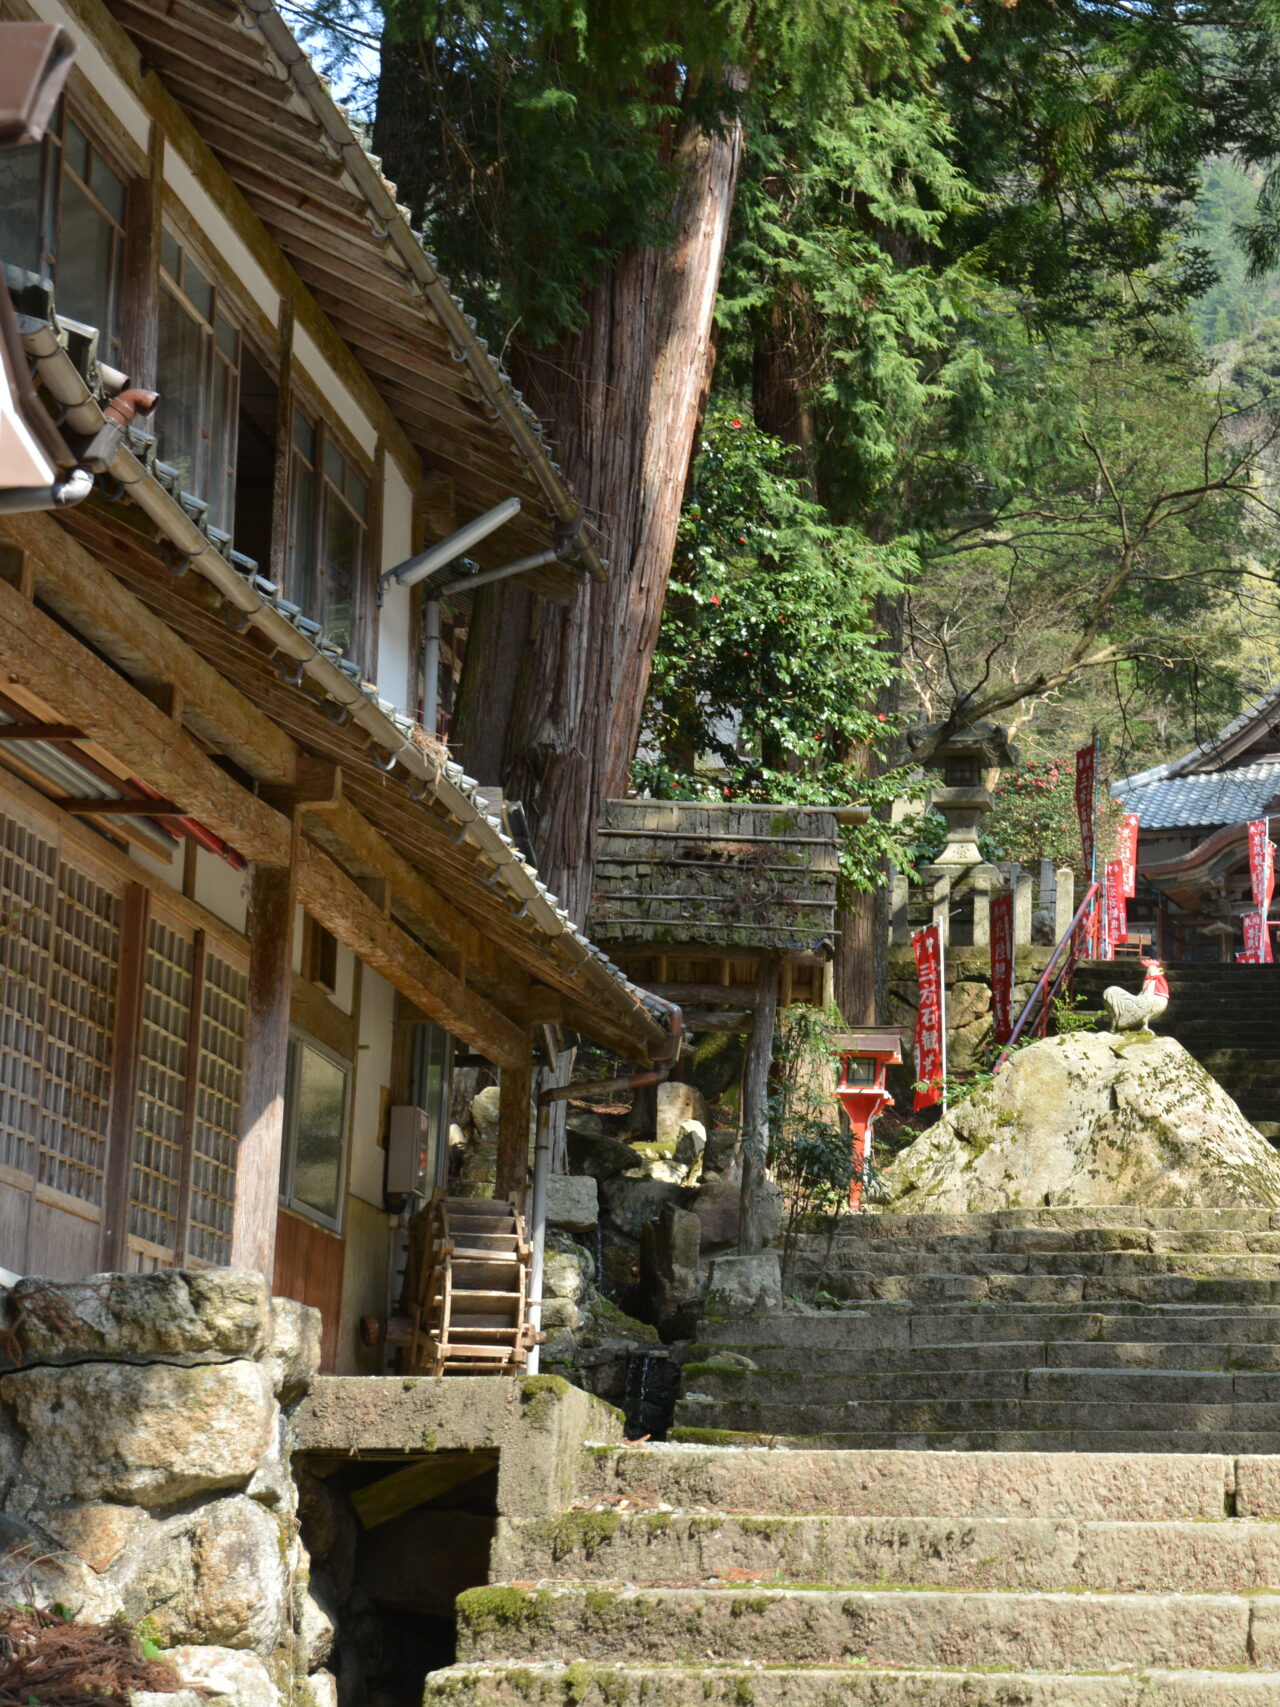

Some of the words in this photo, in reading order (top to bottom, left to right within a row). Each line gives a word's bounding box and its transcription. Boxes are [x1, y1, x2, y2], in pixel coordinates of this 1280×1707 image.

[918, 963, 939, 1093] 三方石観世
